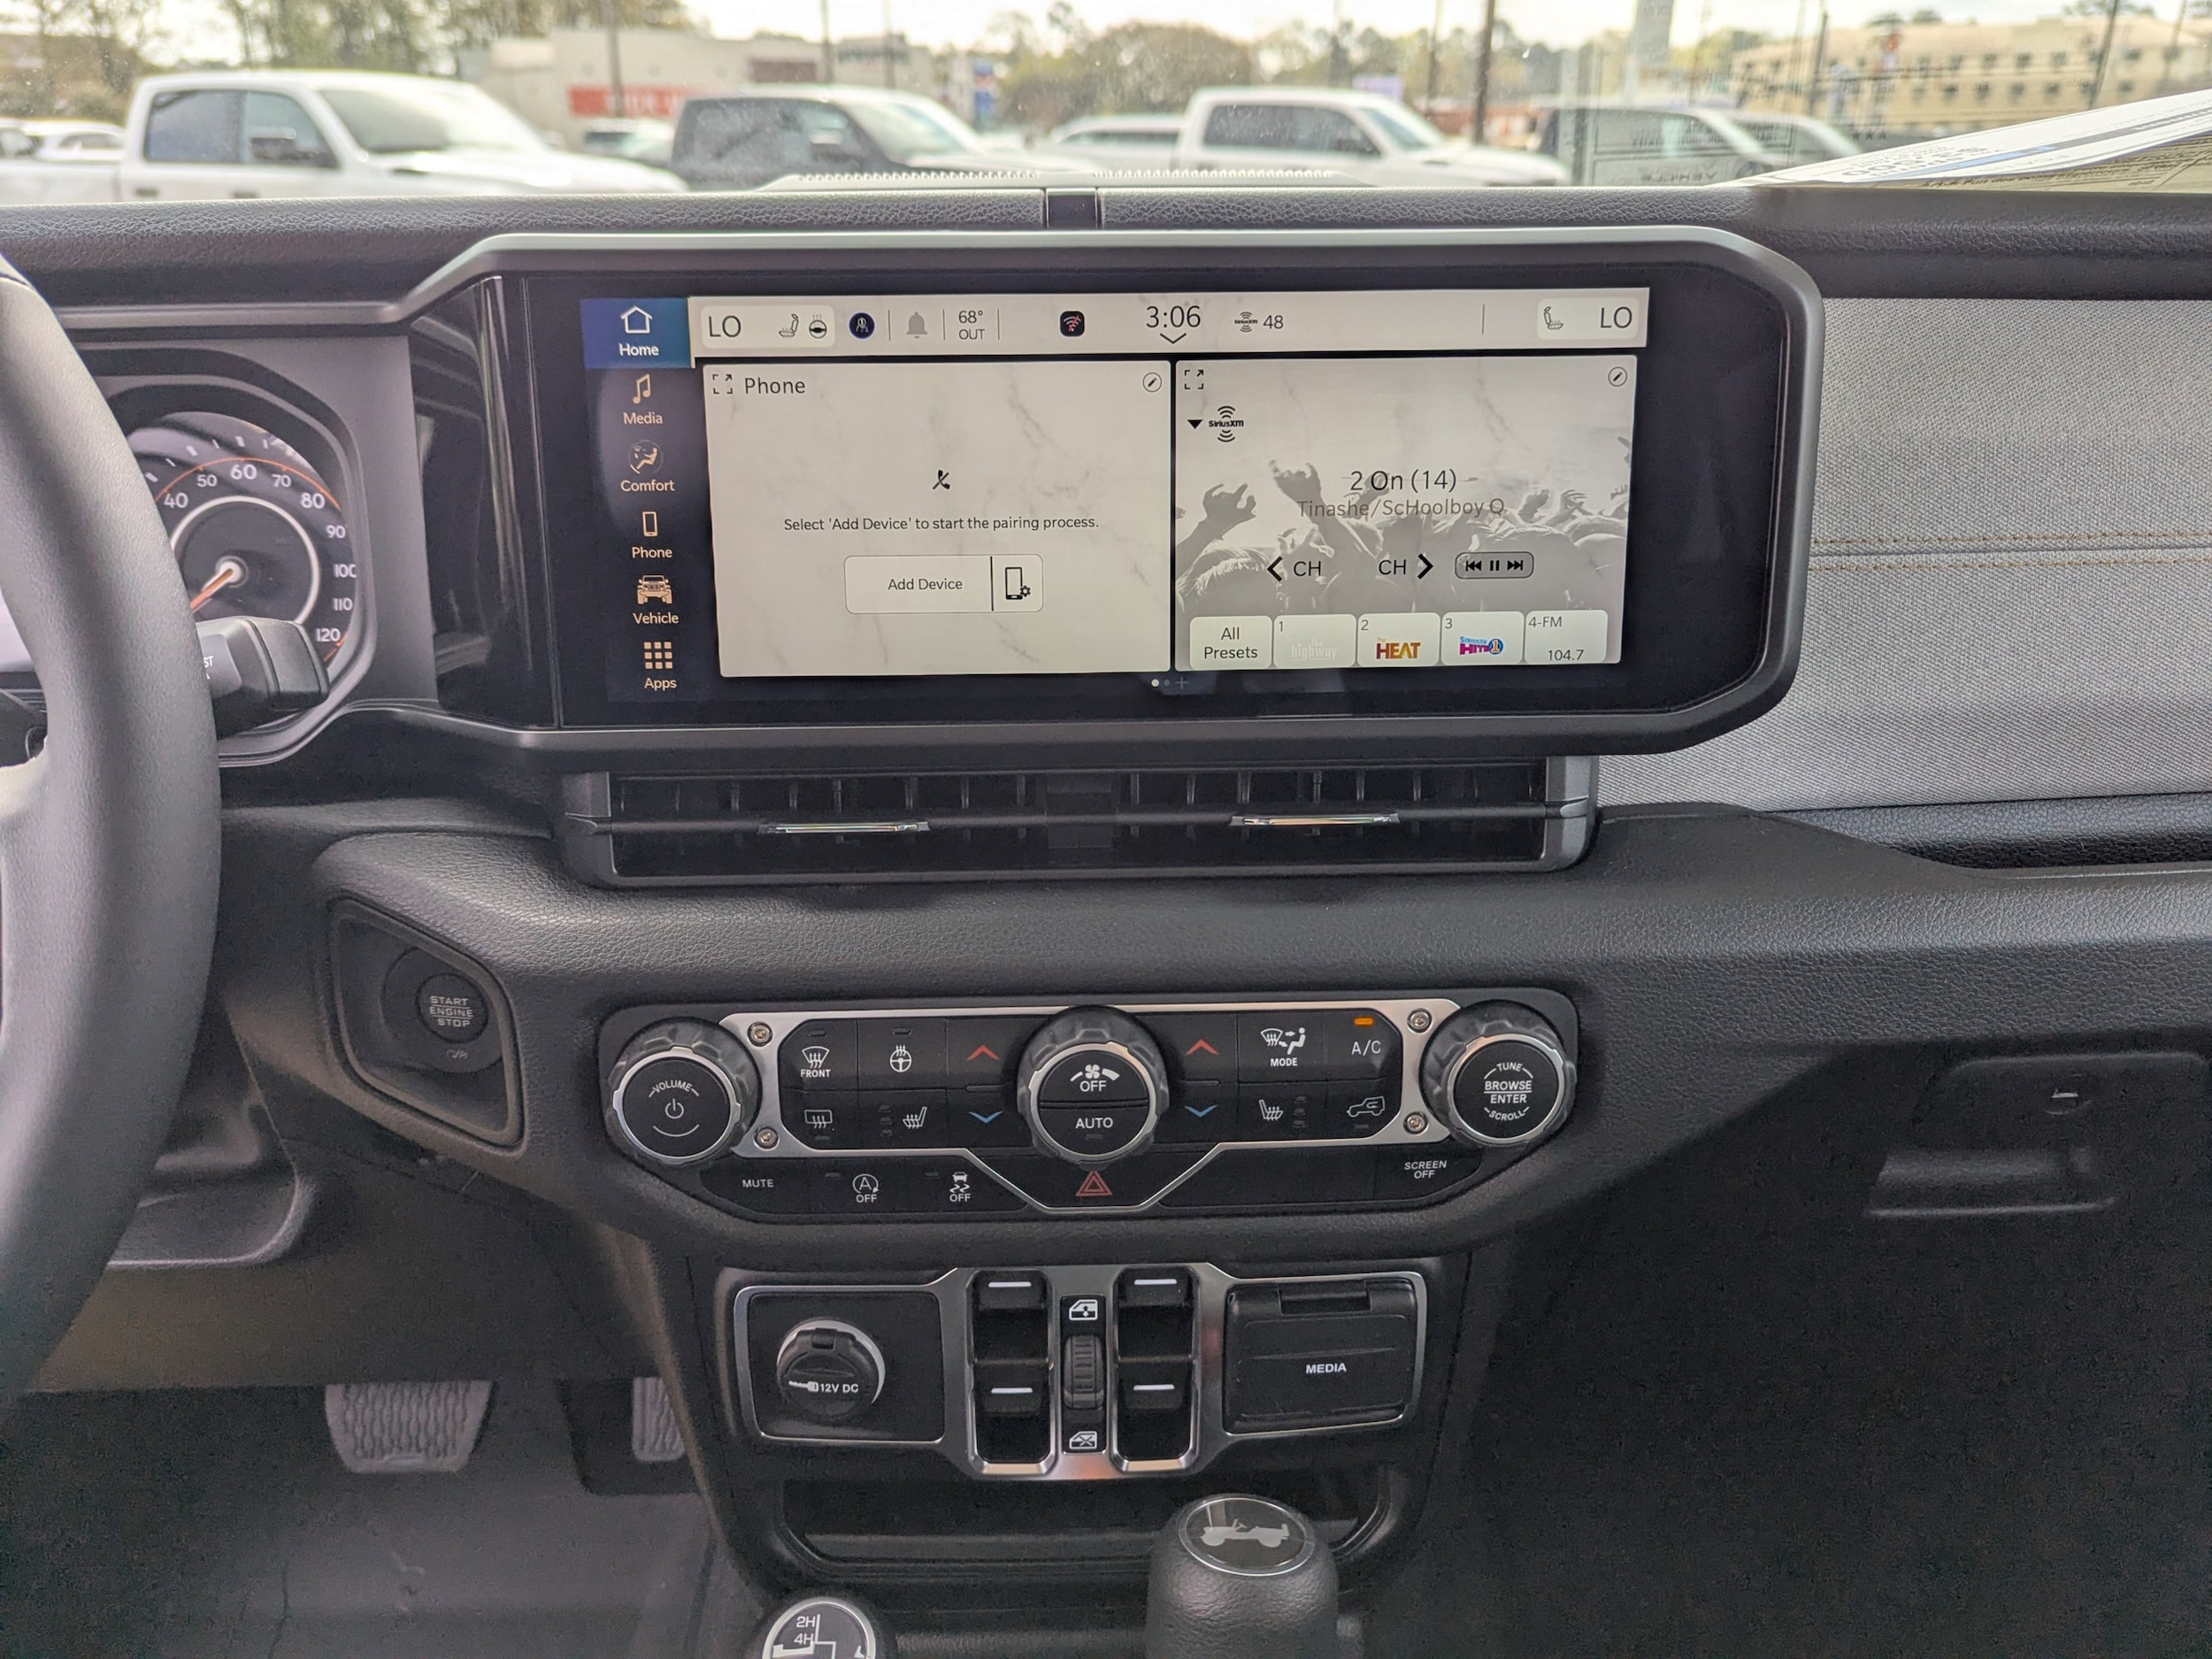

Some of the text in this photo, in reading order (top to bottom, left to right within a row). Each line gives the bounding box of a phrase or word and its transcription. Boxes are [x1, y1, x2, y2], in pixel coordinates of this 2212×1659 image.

[958, 310, 984, 324] 68°
[1146, 304, 1202, 329] 3:06
[1263, 315, 1284, 329] 48
[1600, 306, 1632, 329] LO
[708, 315, 742, 338] LO
[958, 328, 986, 340] OUT
[619, 342, 659, 357] Home
[744, 378, 806, 395] Phone
[623, 412, 664, 425] Media
[230, 464, 257, 480] 60
[197, 474, 218, 488] 50
[272, 474, 291, 488] 70
[620, 479, 675, 492] Comfort
[1350, 468, 1457, 493] 2 On (14)
[164, 492, 188, 508] 40
[300, 493, 326, 509] 80
[1297, 498, 1505, 518] Tinashe/ScHoolboy Q
[784, 516, 1099, 532] Select 'Add Device' to start the pairing process.
[326, 525, 346, 539] 90
[632, 546, 673, 558] Phone
[334, 564, 357, 578] 100
[1294, 561, 1322, 576] CH
[1379, 559, 1407, 575] CH
[887, 578, 963, 590] Add Device
[334, 598, 353, 611] 110
[633, 612, 680, 624] Vehicle
[1445, 618, 1453, 629] 3
[1528, 616, 1563, 628] 4-FM
[1279, 621, 1284, 633] 1
[1361, 619, 1370, 631] 2
[316, 628, 341, 641] 120
[1221, 626, 1240, 640] All
[1204, 646, 1258, 659] Presets
[1376, 642, 1421, 659] HEAT
[1548, 649, 1585, 661] 104.7
[644, 678, 678, 691] Apps
[430, 995, 469, 1006] START
[429, 1007, 474, 1018] ENGINE
[437, 1018, 471, 1027] STOP
[1351, 1039, 1382, 1056] A/C
[1270, 1057, 1298, 1067] MODE
[1496, 1062, 1523, 1073] TUNE
[801, 1068, 831, 1078] FRONT
[653, 1080, 693, 1094] VOLUME
[1079, 1080, 1107, 1092] OFF
[1484, 1079, 1532, 1092] BROWSE
[1490, 1094, 1527, 1104] ENTER
[1488, 1109, 1525, 1121] SCROLL
[1075, 1117, 1114, 1129] AUTO
[1403, 1160, 1448, 1170] SCREEN
[1413, 1170, 1435, 1179] OFF
[742, 1179, 774, 1188] MUTE
[856, 1194, 878, 1203] OFF
[949, 1193, 972, 1202] OFF
[1305, 1363, 1347, 1374] MEDIA
[819, 1383, 859, 1393] 12V DC
[796, 1616, 816, 1627] 2H
[794, 1633, 814, 1645] 4H
